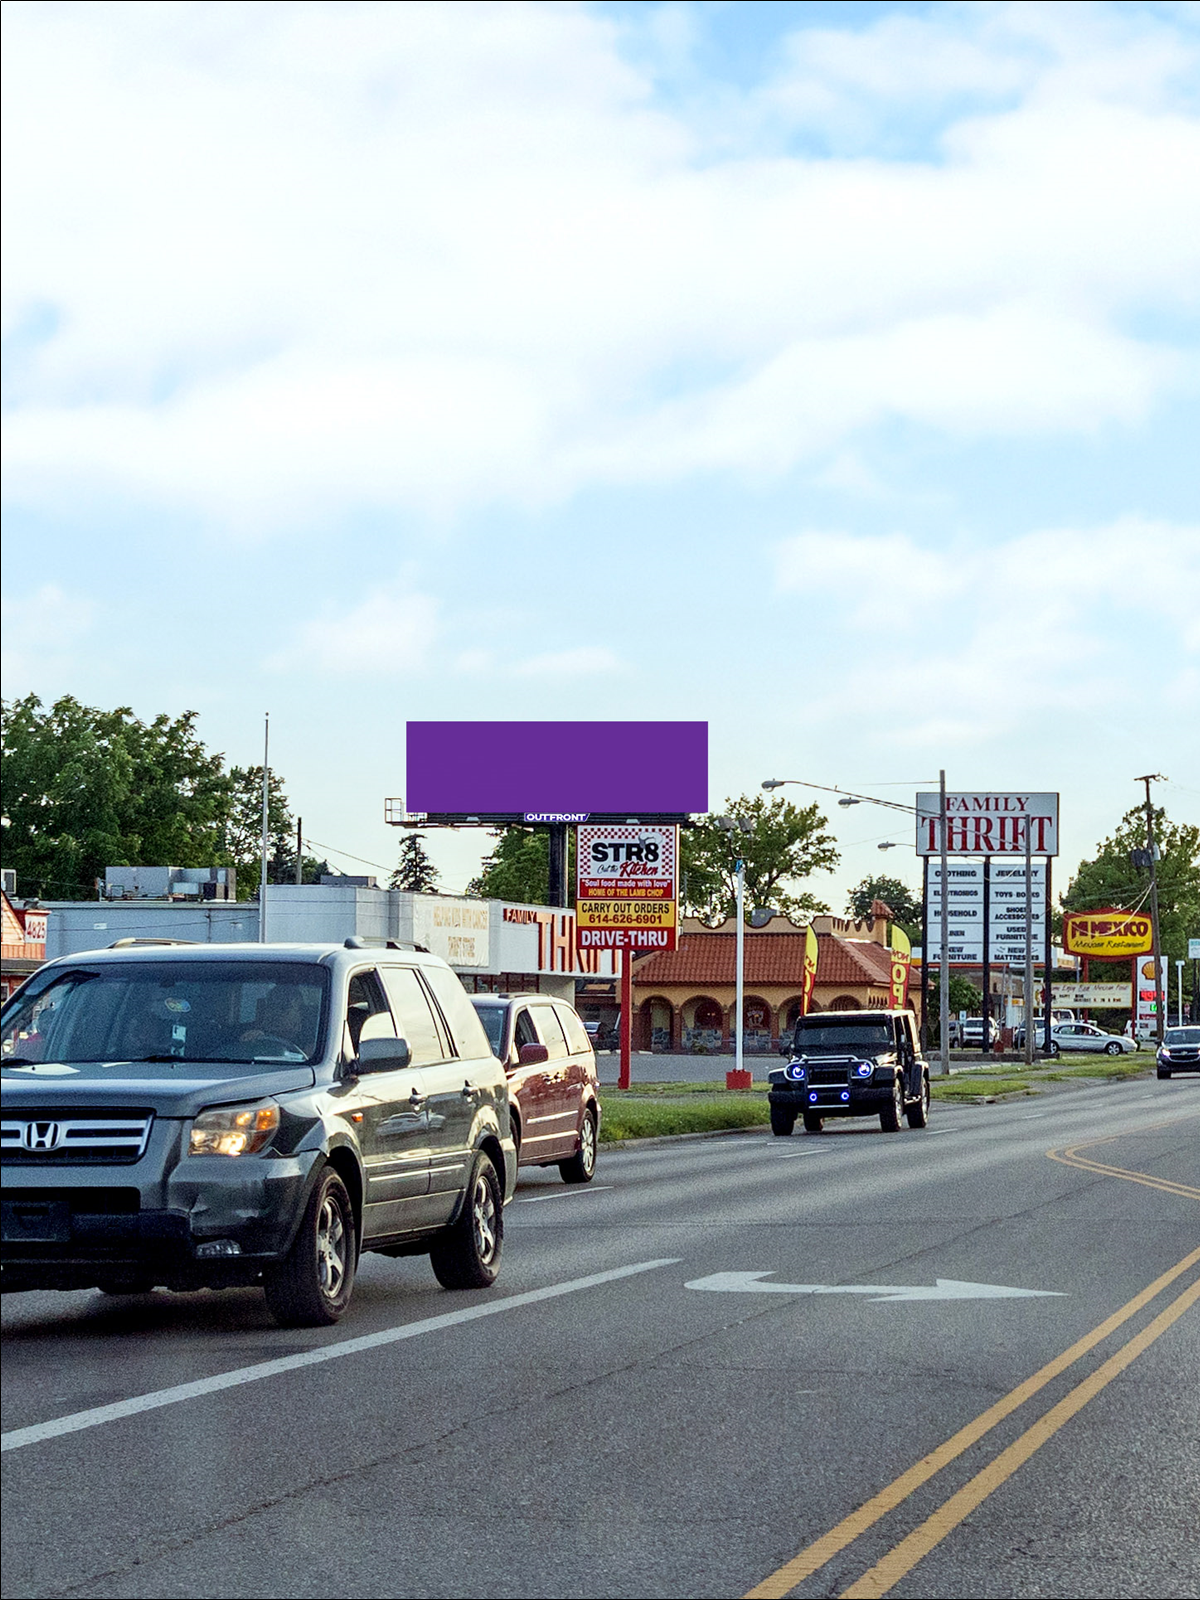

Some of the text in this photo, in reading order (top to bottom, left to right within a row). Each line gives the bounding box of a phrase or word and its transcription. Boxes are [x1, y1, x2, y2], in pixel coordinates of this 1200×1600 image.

[945, 797, 1030, 811] FAMILY
[526, 813, 586, 821] OUTFRONT
[921, 816, 1052, 851] THRIFT
[591, 842, 659, 862] STR8
[619, 860, 659, 877] Kitchen
[601, 879, 615, 887] food
[637, 879, 652, 887] with
[503, 908, 537, 924] FAMILY
[581, 903, 670, 914] CARRY OUT ORDERS
[588, 914, 663, 924] 614-626-6901
[1071, 921, 1148, 939] MI MEXICO
[581, 930, 668, 946] DRIVE-THRU
[1106, 940, 1145, 948] Restaurant
